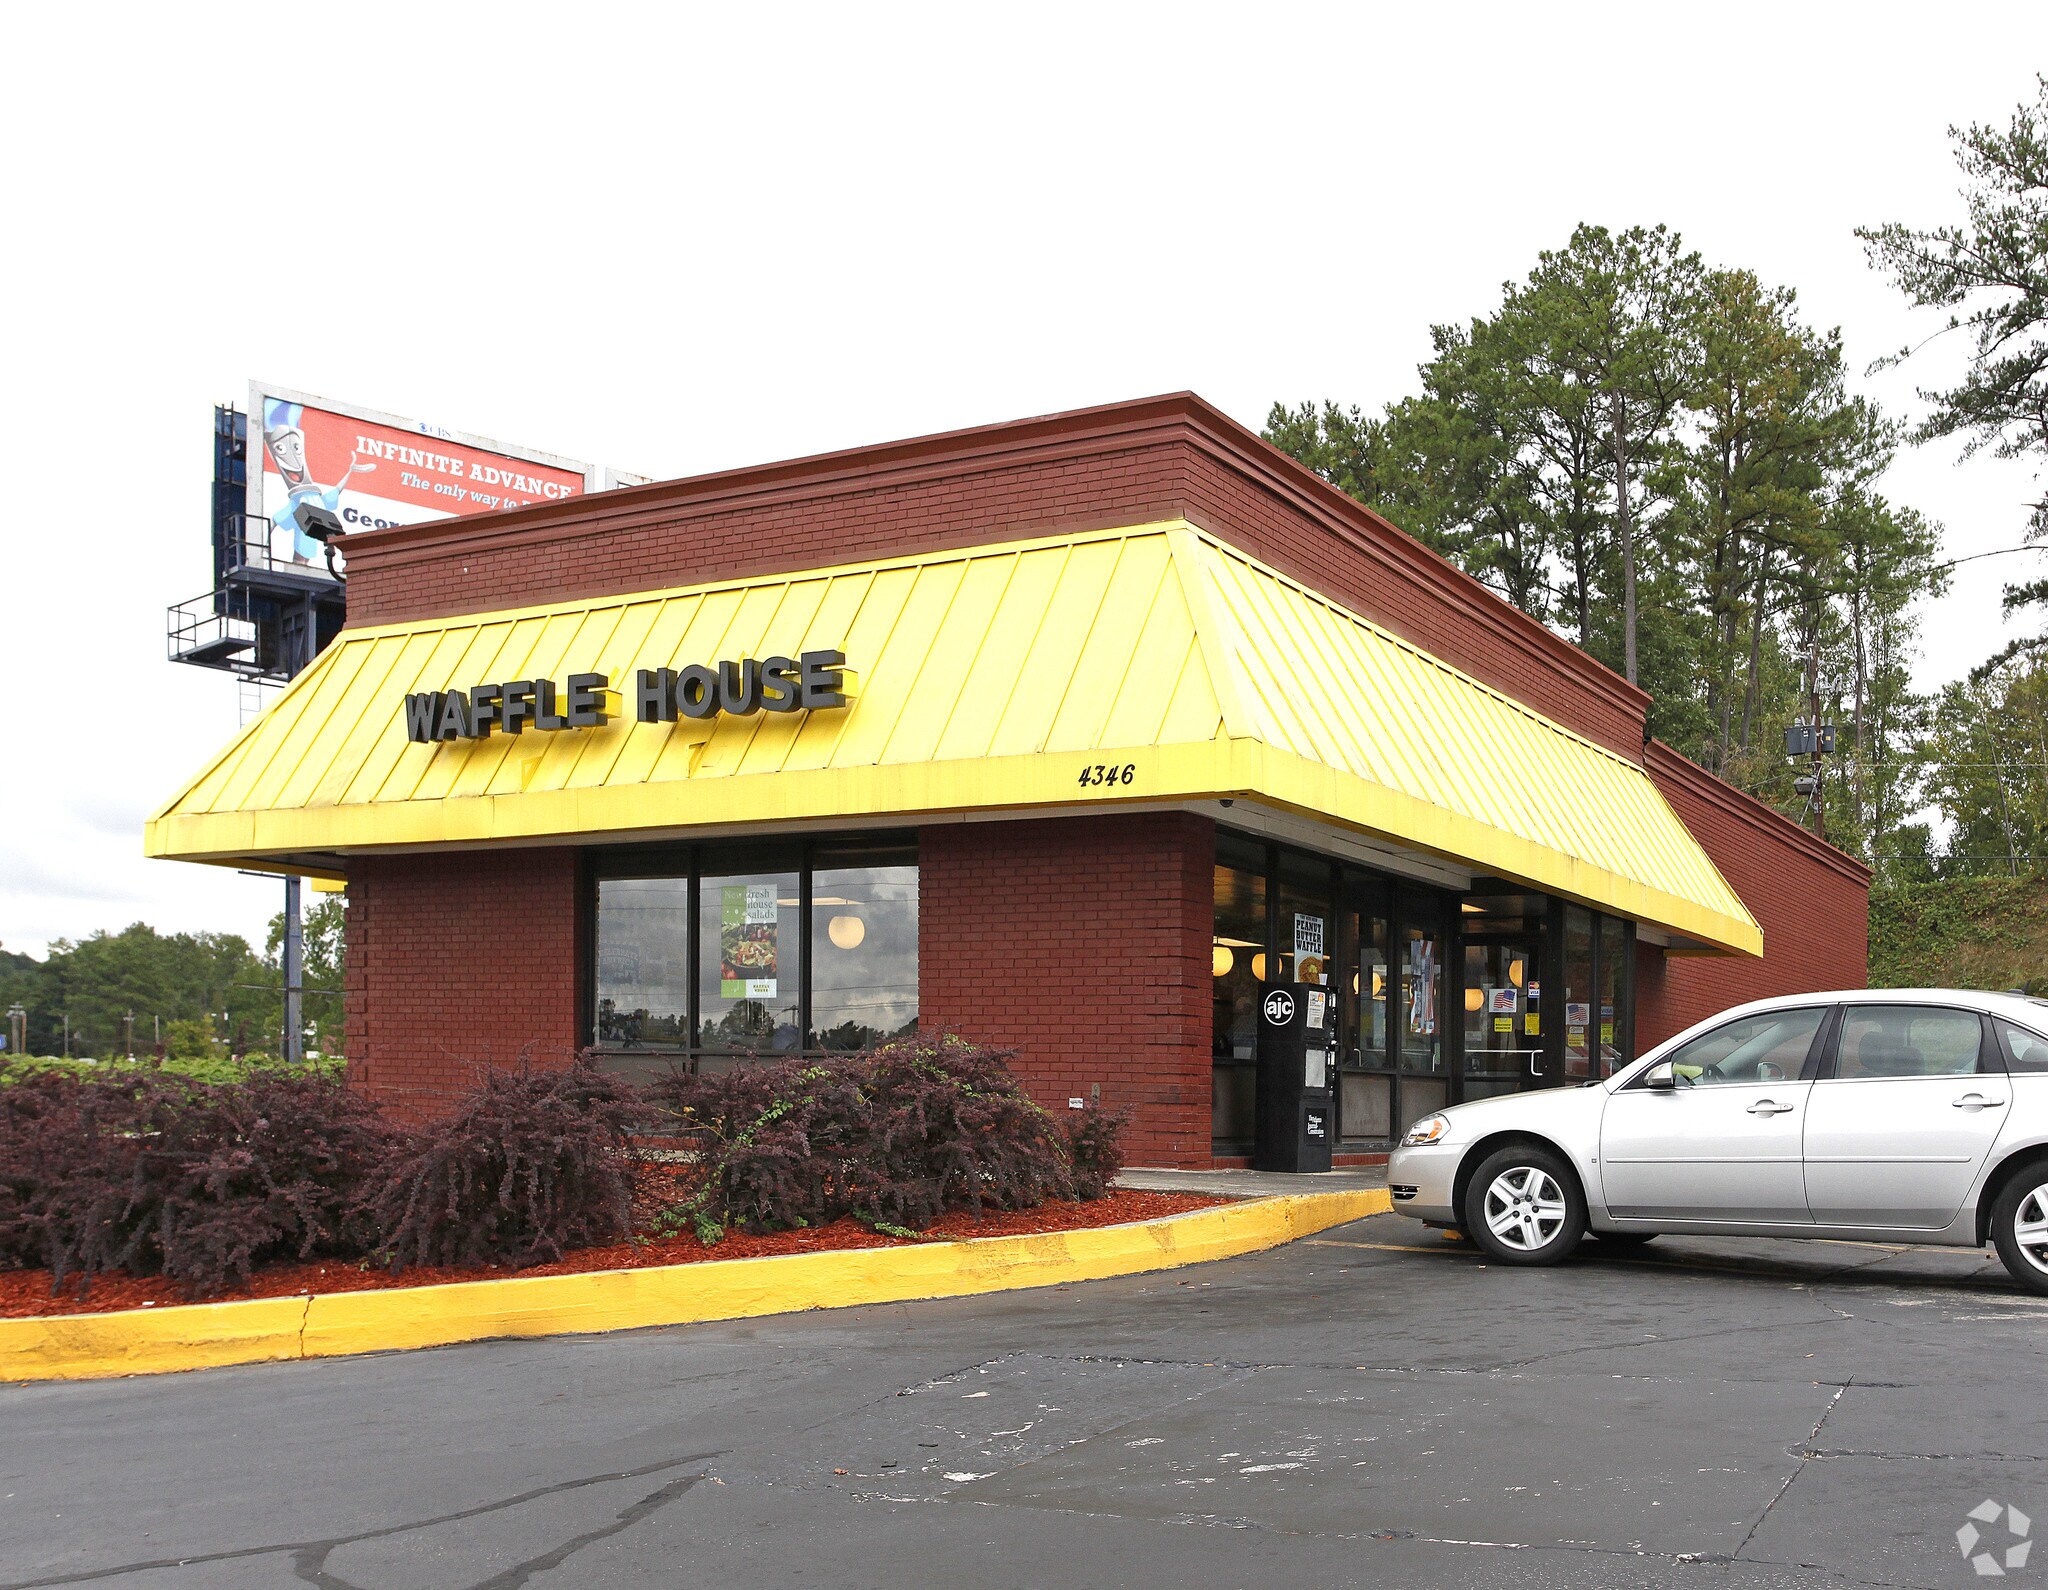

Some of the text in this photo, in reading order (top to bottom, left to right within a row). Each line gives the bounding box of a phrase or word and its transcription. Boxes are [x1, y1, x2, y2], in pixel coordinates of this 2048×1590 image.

[355, 435, 464, 476] INFINITE
[400, 471, 517, 509] The only way to
[404, 649, 846, 743] WAFFLE HOUSE
[1078, 764, 1136, 788] 4346
[747, 888, 770, 899] fresh
[747, 910, 775, 919] salads
[1296, 919, 1321, 934] PEANUT
[1296, 929, 1321, 943] BUTTER
[1296, 940, 1321, 953] WAFFLE
[1266, 997, 1292, 1019] ajc
